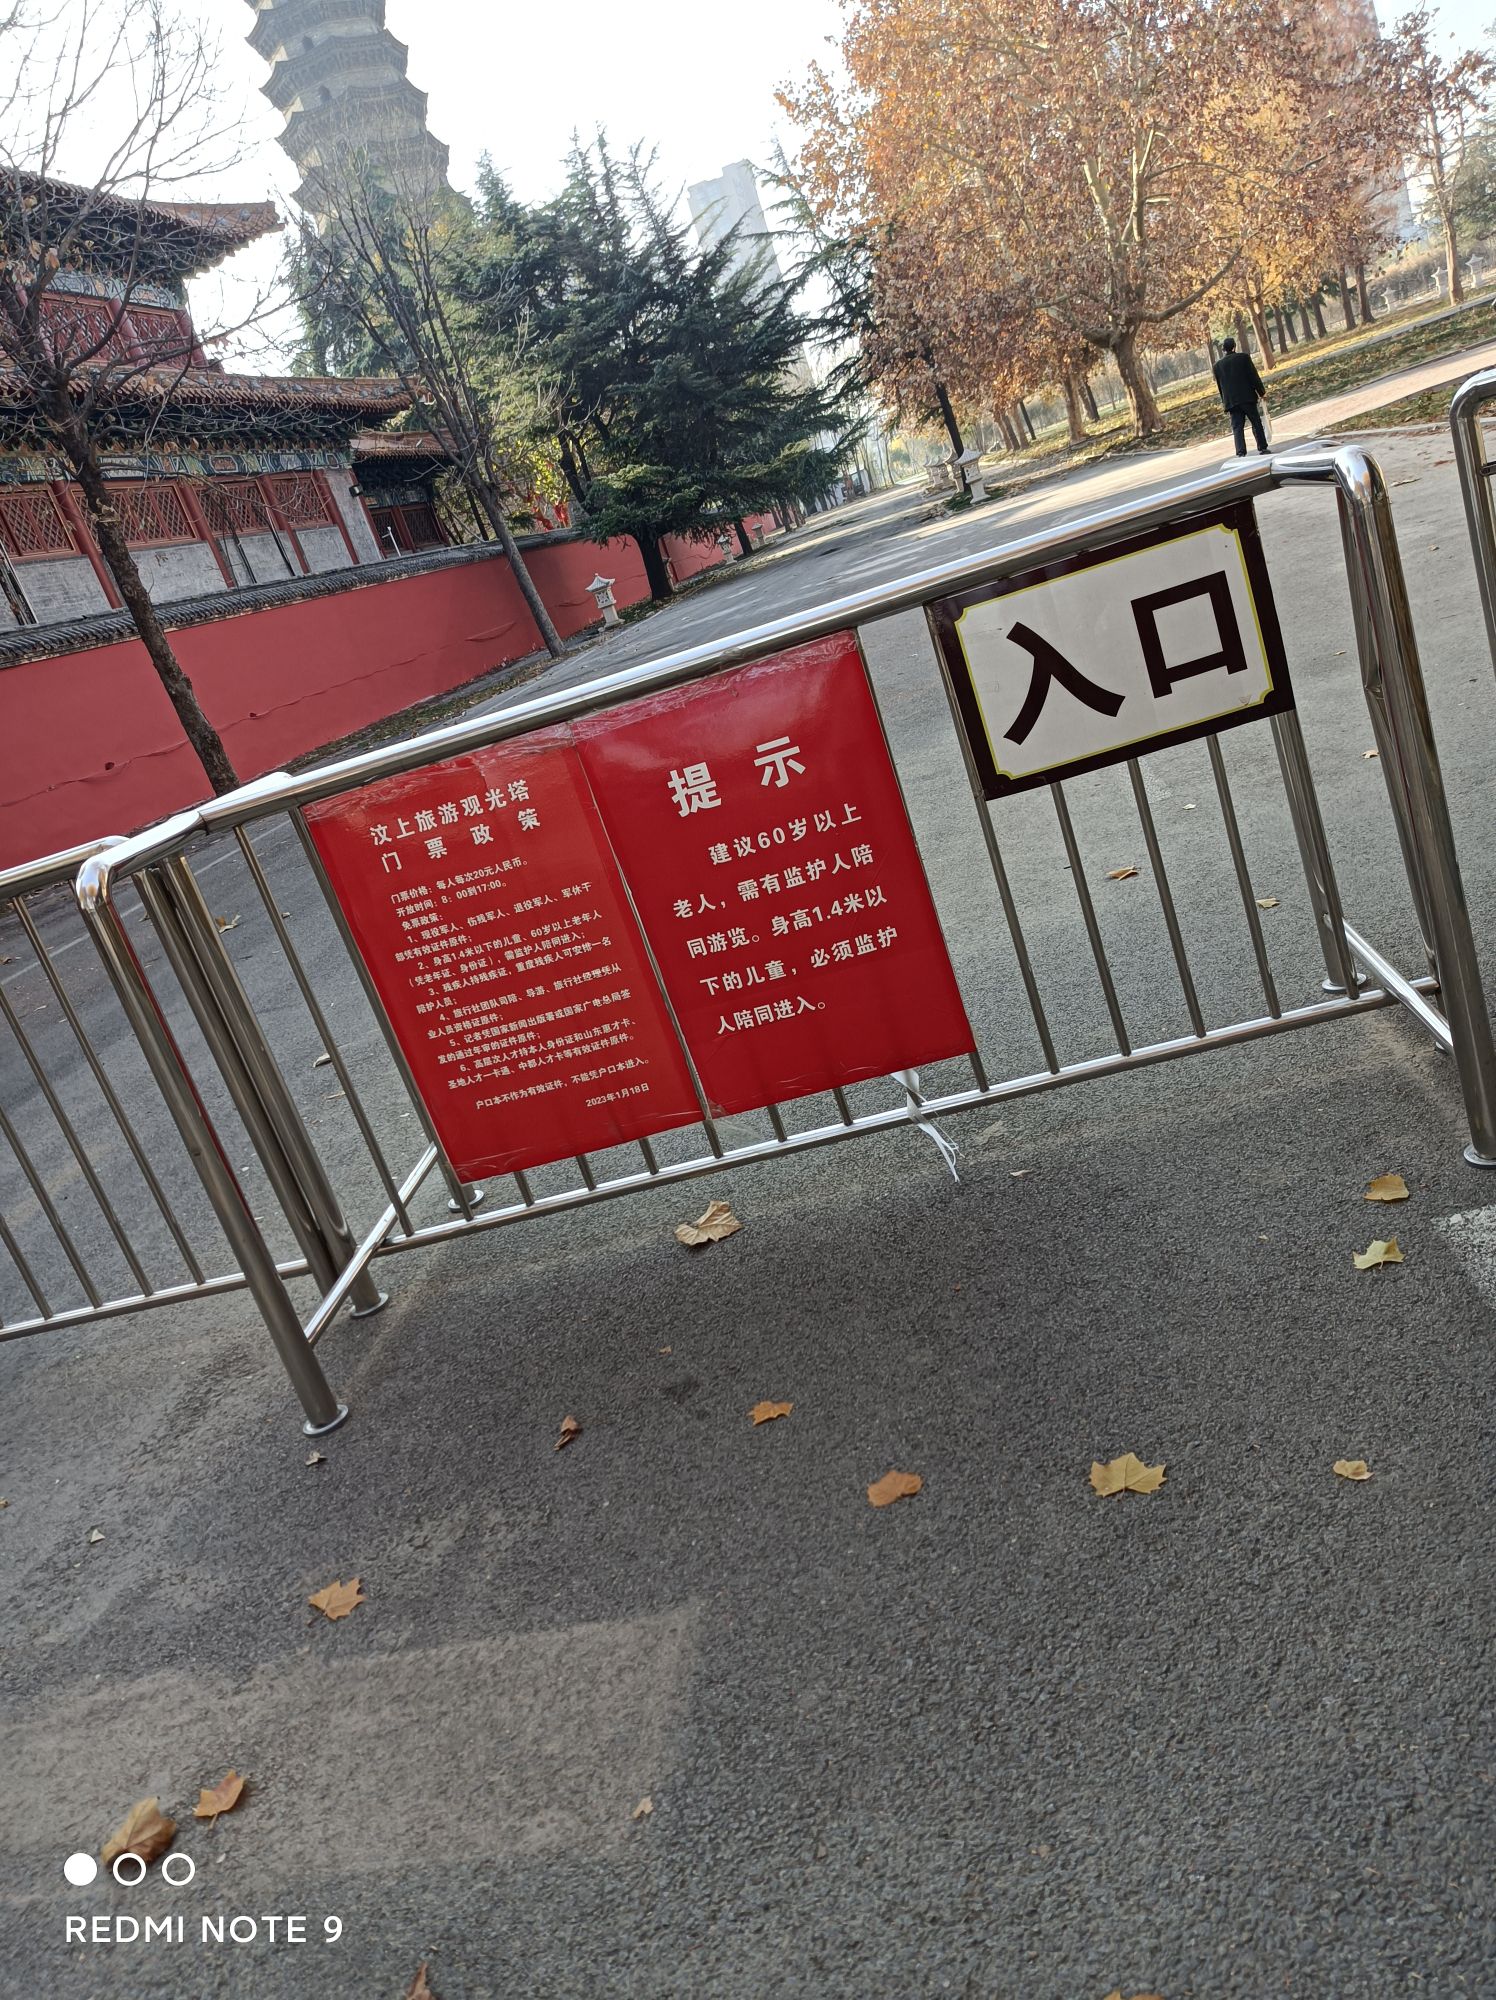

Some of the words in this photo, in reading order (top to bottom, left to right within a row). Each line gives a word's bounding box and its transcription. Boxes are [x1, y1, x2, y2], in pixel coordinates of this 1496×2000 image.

[1004, 571, 1248, 745] 入口
[667, 735, 806, 818] 提示
[369, 778, 530, 846] 汶上旅游观光塔
[707, 803, 862, 866] 建议60岁以上
[390, 856, 528, 904] 门票价格：每人每次20元人民币。
[673, 843, 874, 919] 老人，需有监护人陪
[401, 912, 443, 931] 免票政策：
[686, 885, 888, 959] 同游览。身高1.4米以
[394, 934, 472, 962] 部凭有效证件原件；
[699, 926, 898, 996] 下的儿童，必须监护
[415, 996, 457, 1015] 陪护人员；
[427, 1012, 504, 1040] 业人员资格证原件；
[717, 995, 826, 1035] 人陪同进入。
[437, 1031, 541, 1065] 发的通过年审的证件原件；
[475, 1057, 649, 1110] 户口本不作为有效证件，不能凭户口本进入。
[585, 1082, 650, 1107] 2023年1月18日
